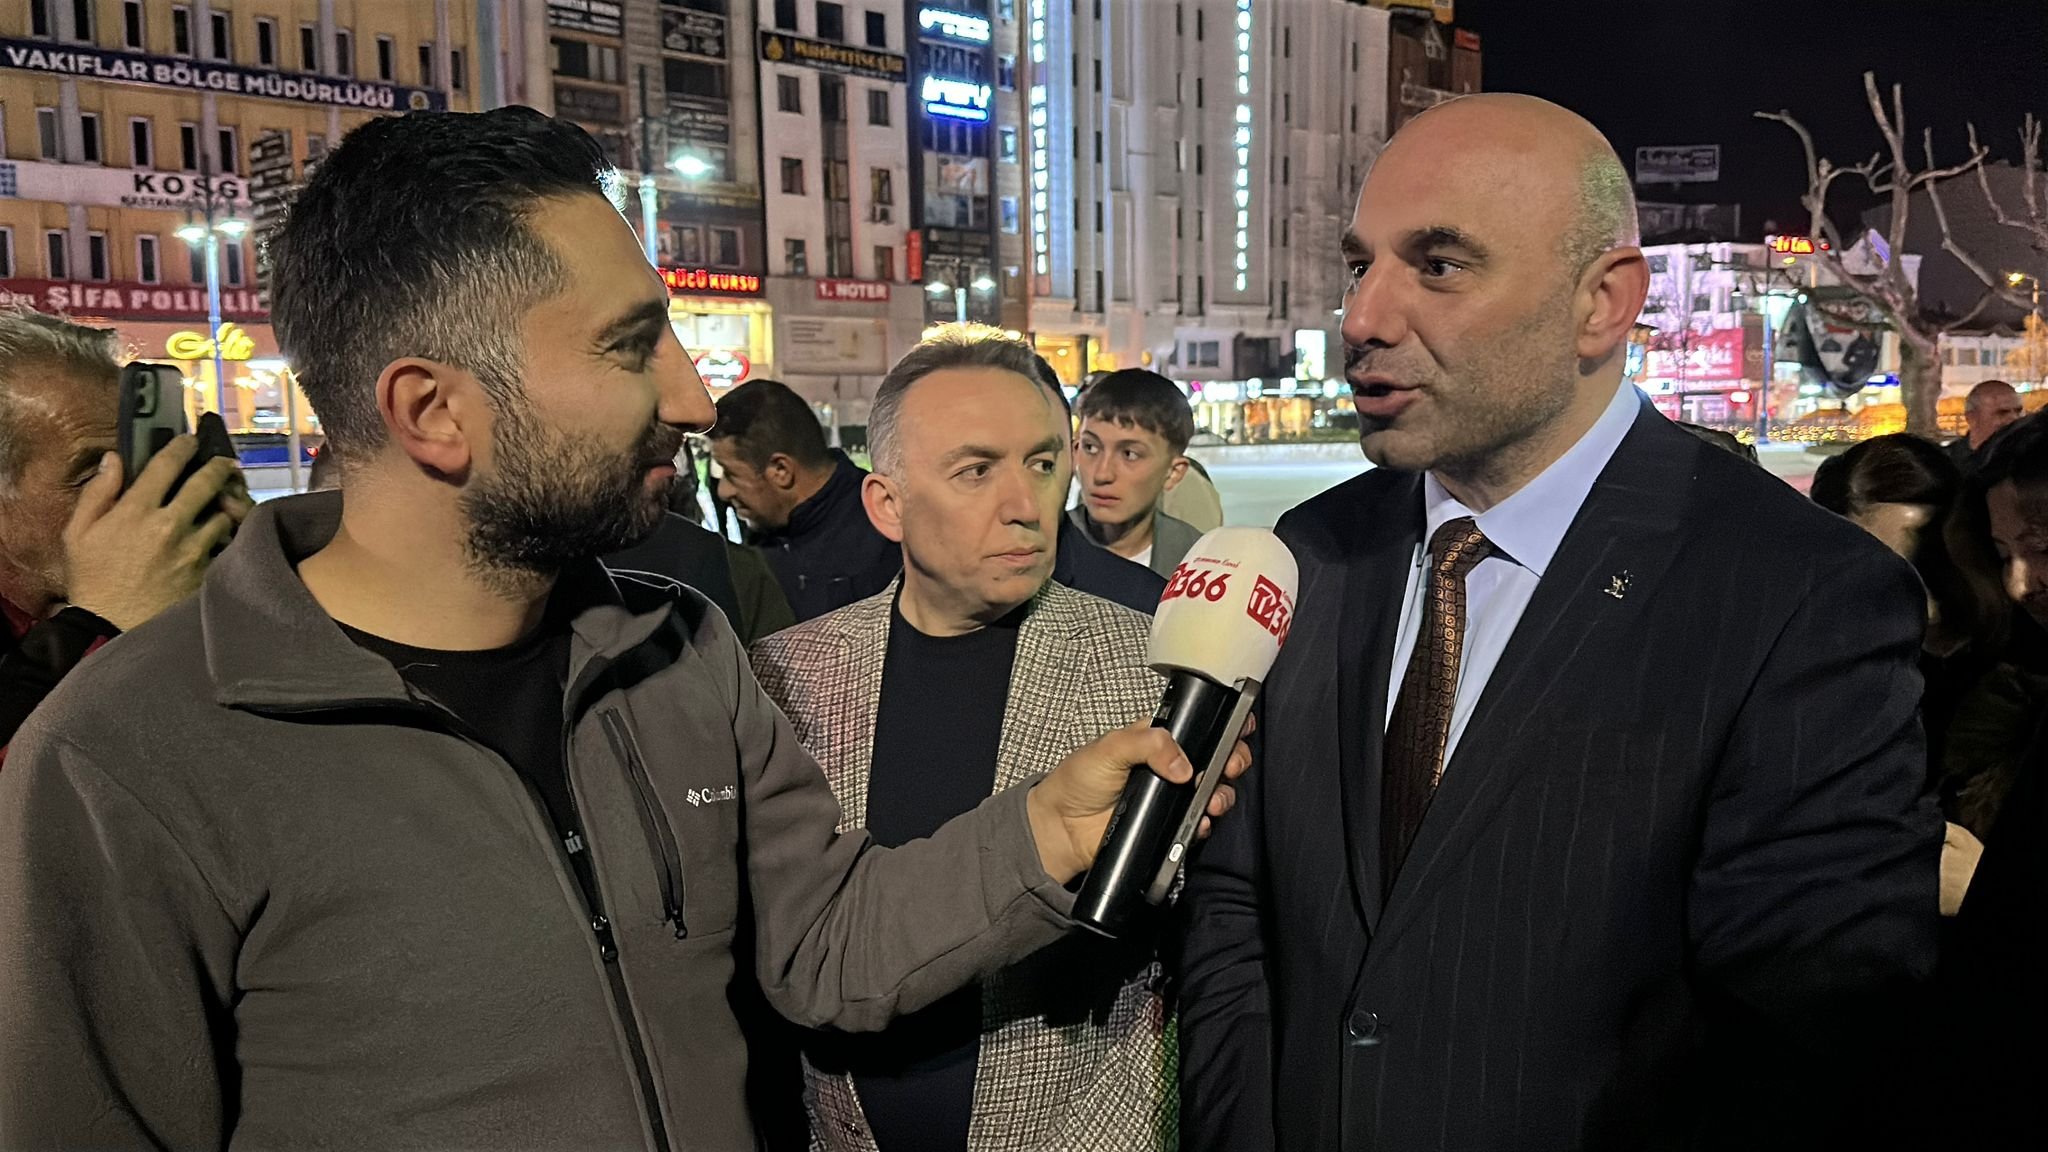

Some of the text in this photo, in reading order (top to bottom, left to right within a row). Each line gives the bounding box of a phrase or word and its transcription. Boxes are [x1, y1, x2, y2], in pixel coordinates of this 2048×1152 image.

[7, 46, 394, 108] VAKIFLAR BÖLGE MÜDÜRLÜĞÜ
[709, 274, 760, 292] KURSU
[836, 282, 887, 299] NOTER
[130, 289, 262, 313] POLİLİ
